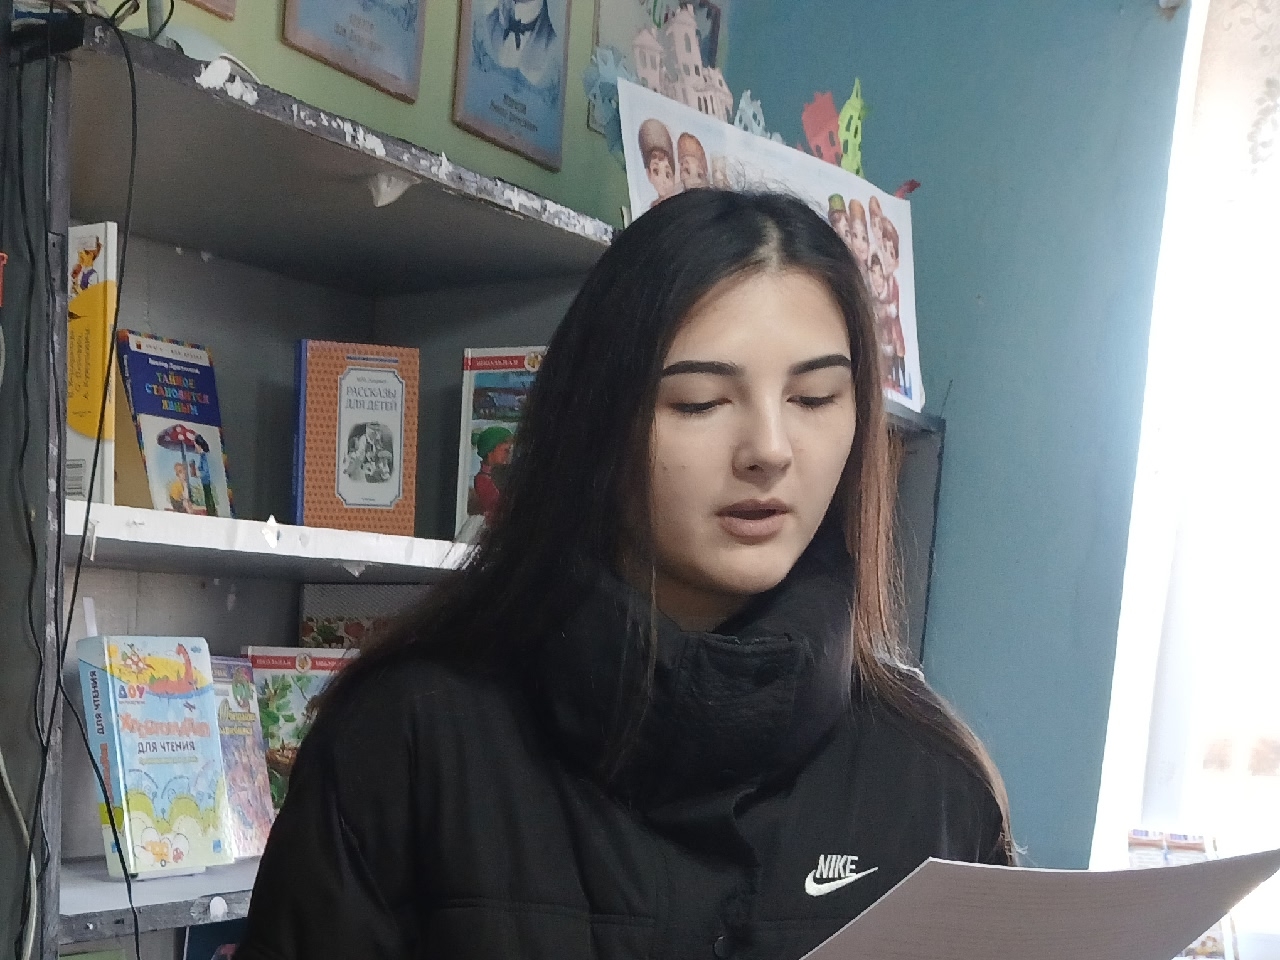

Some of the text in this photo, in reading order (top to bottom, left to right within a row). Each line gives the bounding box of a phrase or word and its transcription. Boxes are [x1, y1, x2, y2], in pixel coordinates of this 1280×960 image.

[156, 372, 195, 389] ТАЙНОЕ
[145, 383, 210, 405] СТАНОВИТСЯ
[346, 386, 397, 399] РАССКАЗЫ
[345, 399, 398, 412] ДЛЯ ДЕТЕЙ
[138, 740, 195, 754] ДЛЯ ЧТЕНИЯ
[815, 854, 859, 878] NIKE
